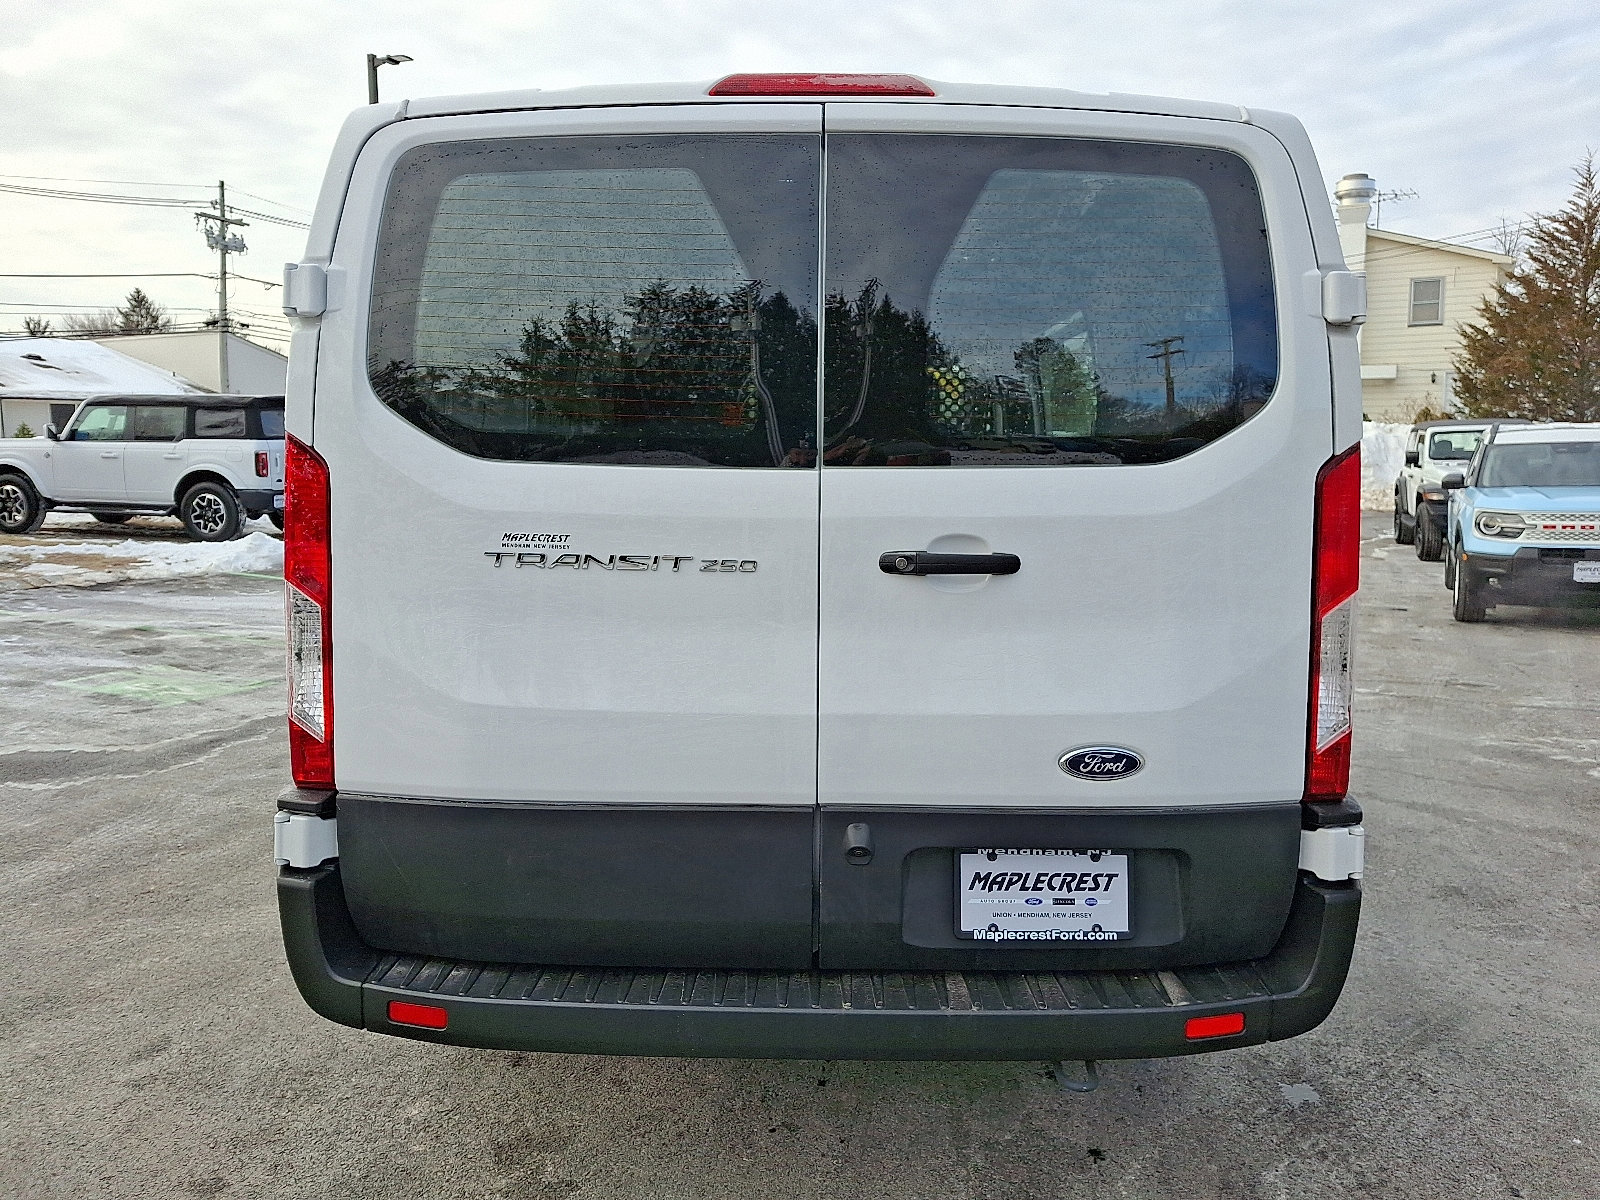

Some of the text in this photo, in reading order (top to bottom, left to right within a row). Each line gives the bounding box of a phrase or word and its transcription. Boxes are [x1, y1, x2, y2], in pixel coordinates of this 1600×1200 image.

[501, 532, 571, 543] MAPLECREST
[484, 551, 759, 573] TRANSIT 250
[1079, 753, 1128, 773] Ford
[968, 872, 1119, 894] MAPLECREST
[1052, 911, 1067, 919] NEW
[973, 929, 1118, 942] MaplecrestFord.com
